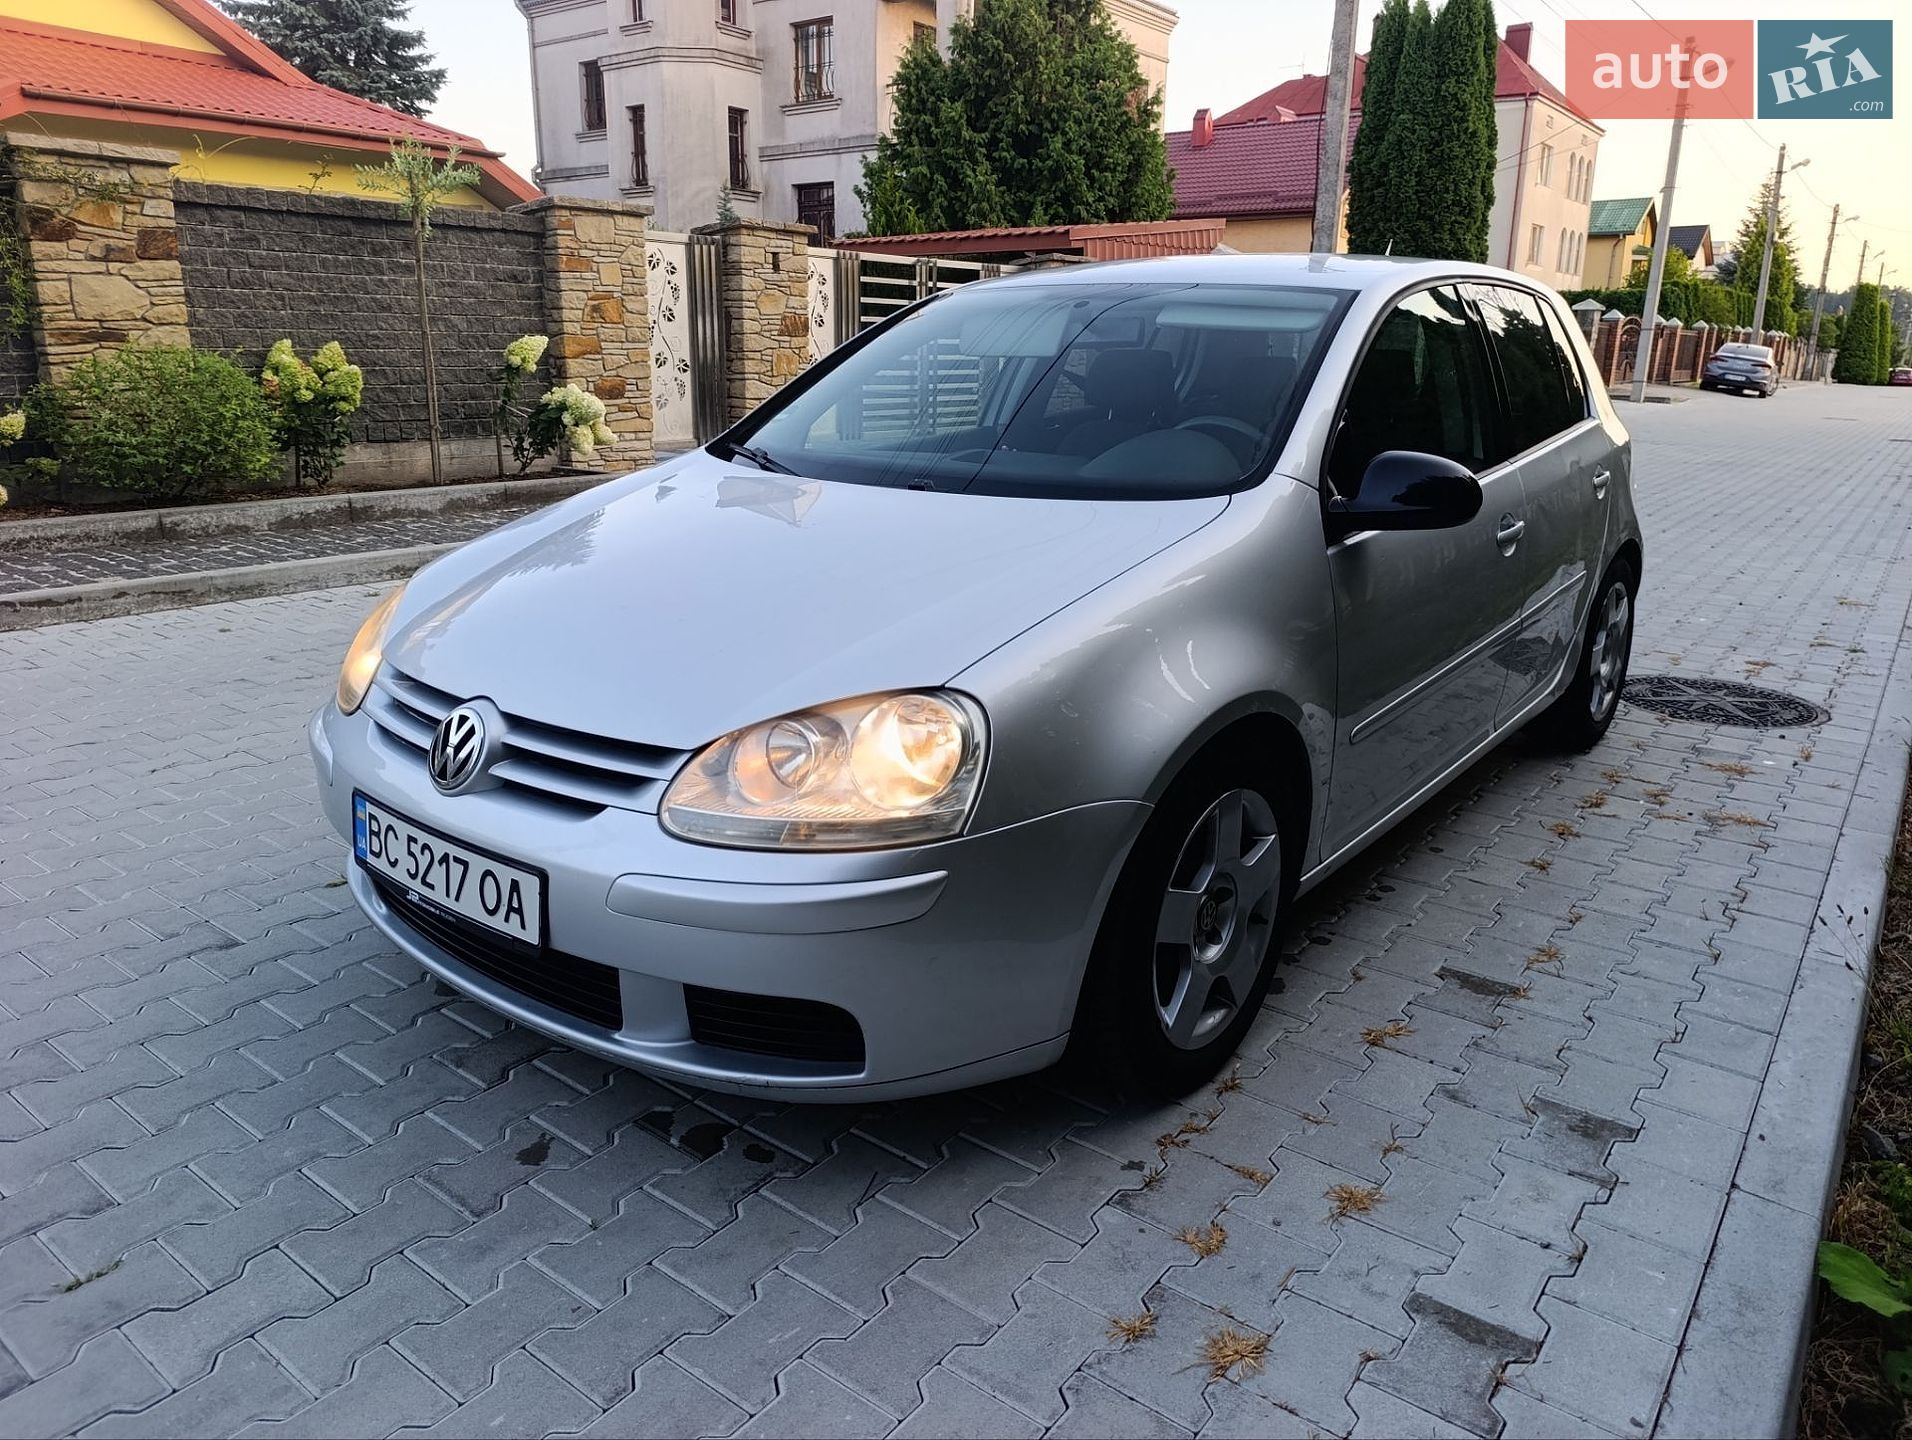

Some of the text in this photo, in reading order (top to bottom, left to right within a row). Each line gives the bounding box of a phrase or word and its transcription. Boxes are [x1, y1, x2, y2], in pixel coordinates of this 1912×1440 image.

[368, 811, 399, 869] BC
[406, 833, 470, 903] 5217
[479, 868, 527, 932] OA
